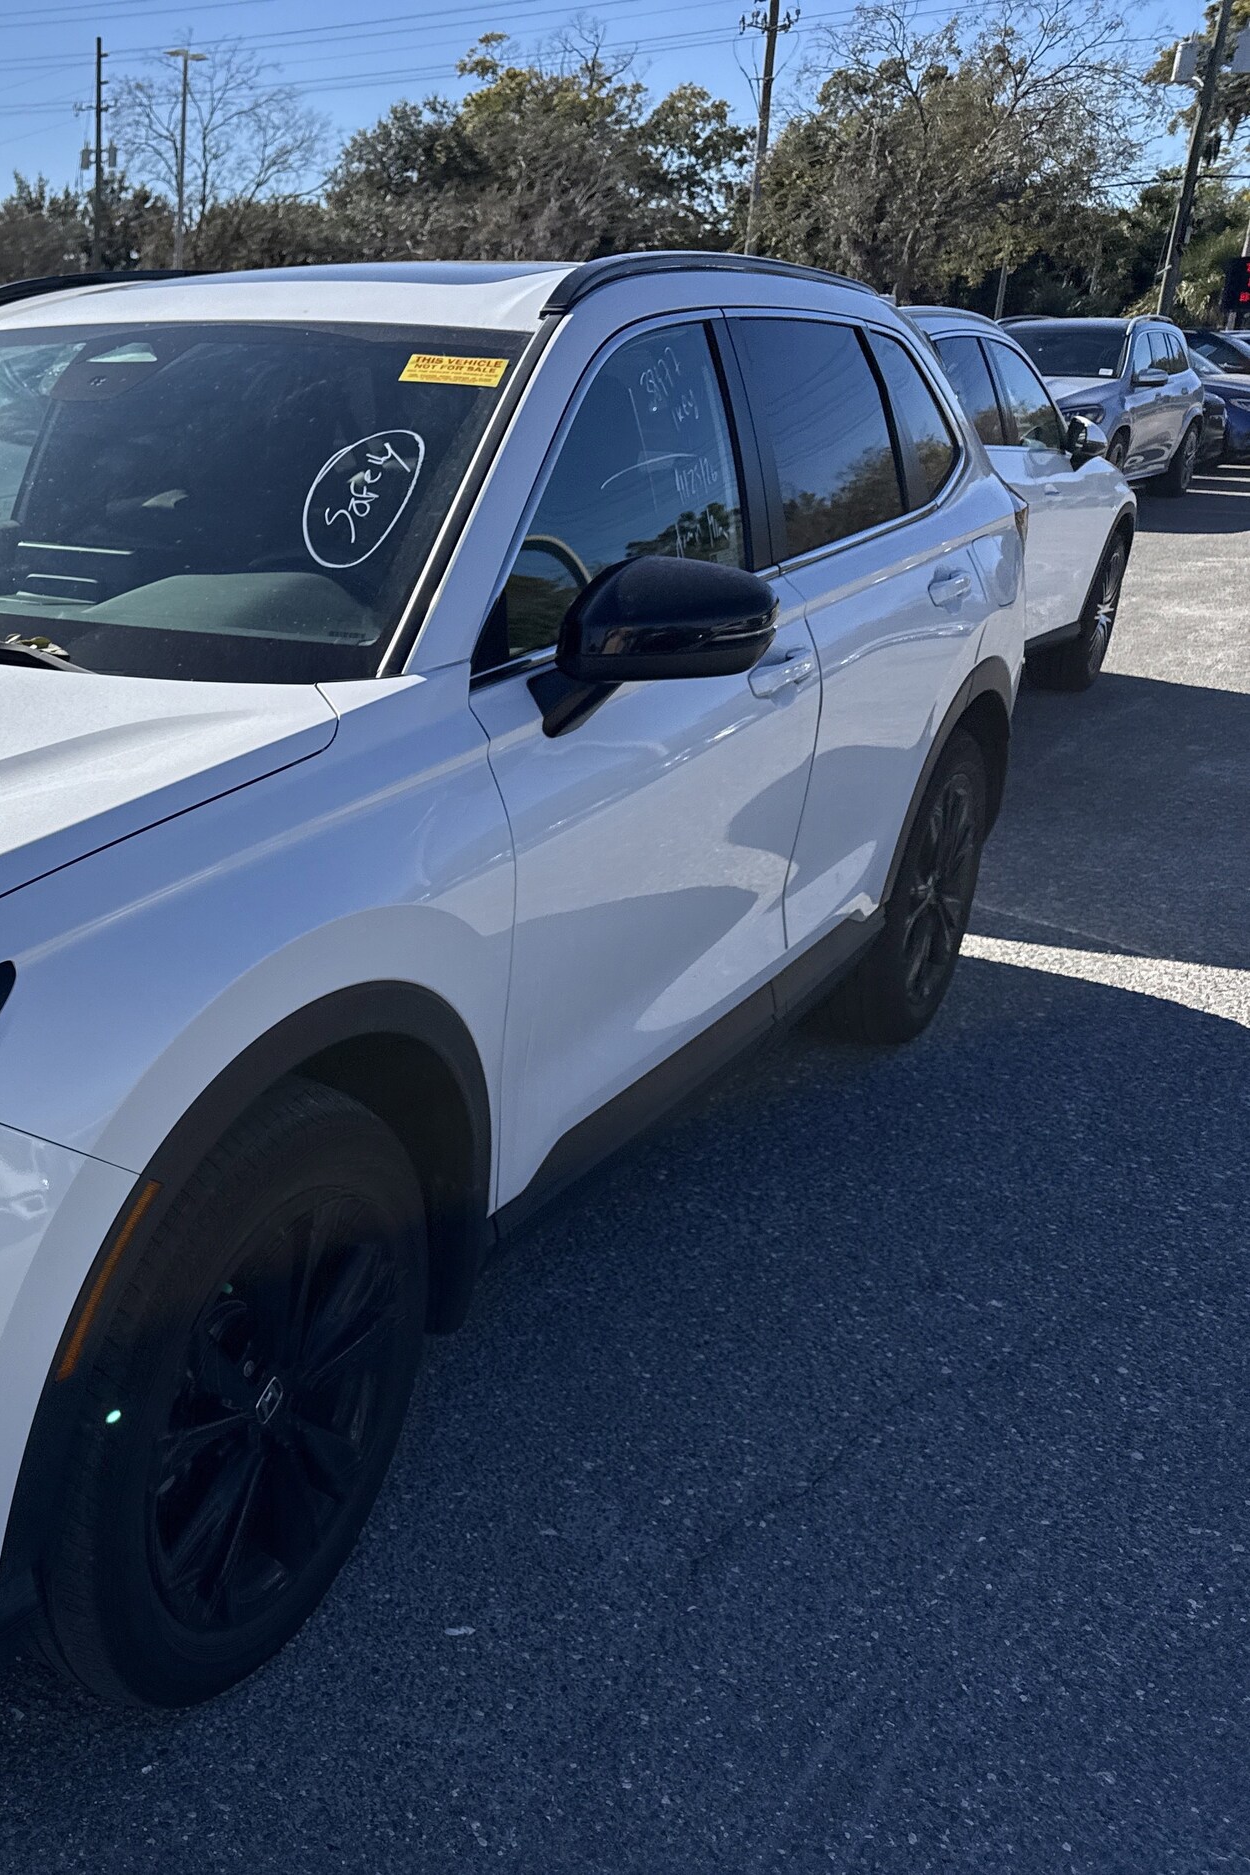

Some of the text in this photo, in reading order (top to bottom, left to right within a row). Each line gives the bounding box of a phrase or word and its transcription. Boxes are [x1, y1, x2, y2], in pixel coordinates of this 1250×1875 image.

[415, 356, 503, 368] THIS VEHICLE
[467, 365, 497, 374] SALE
